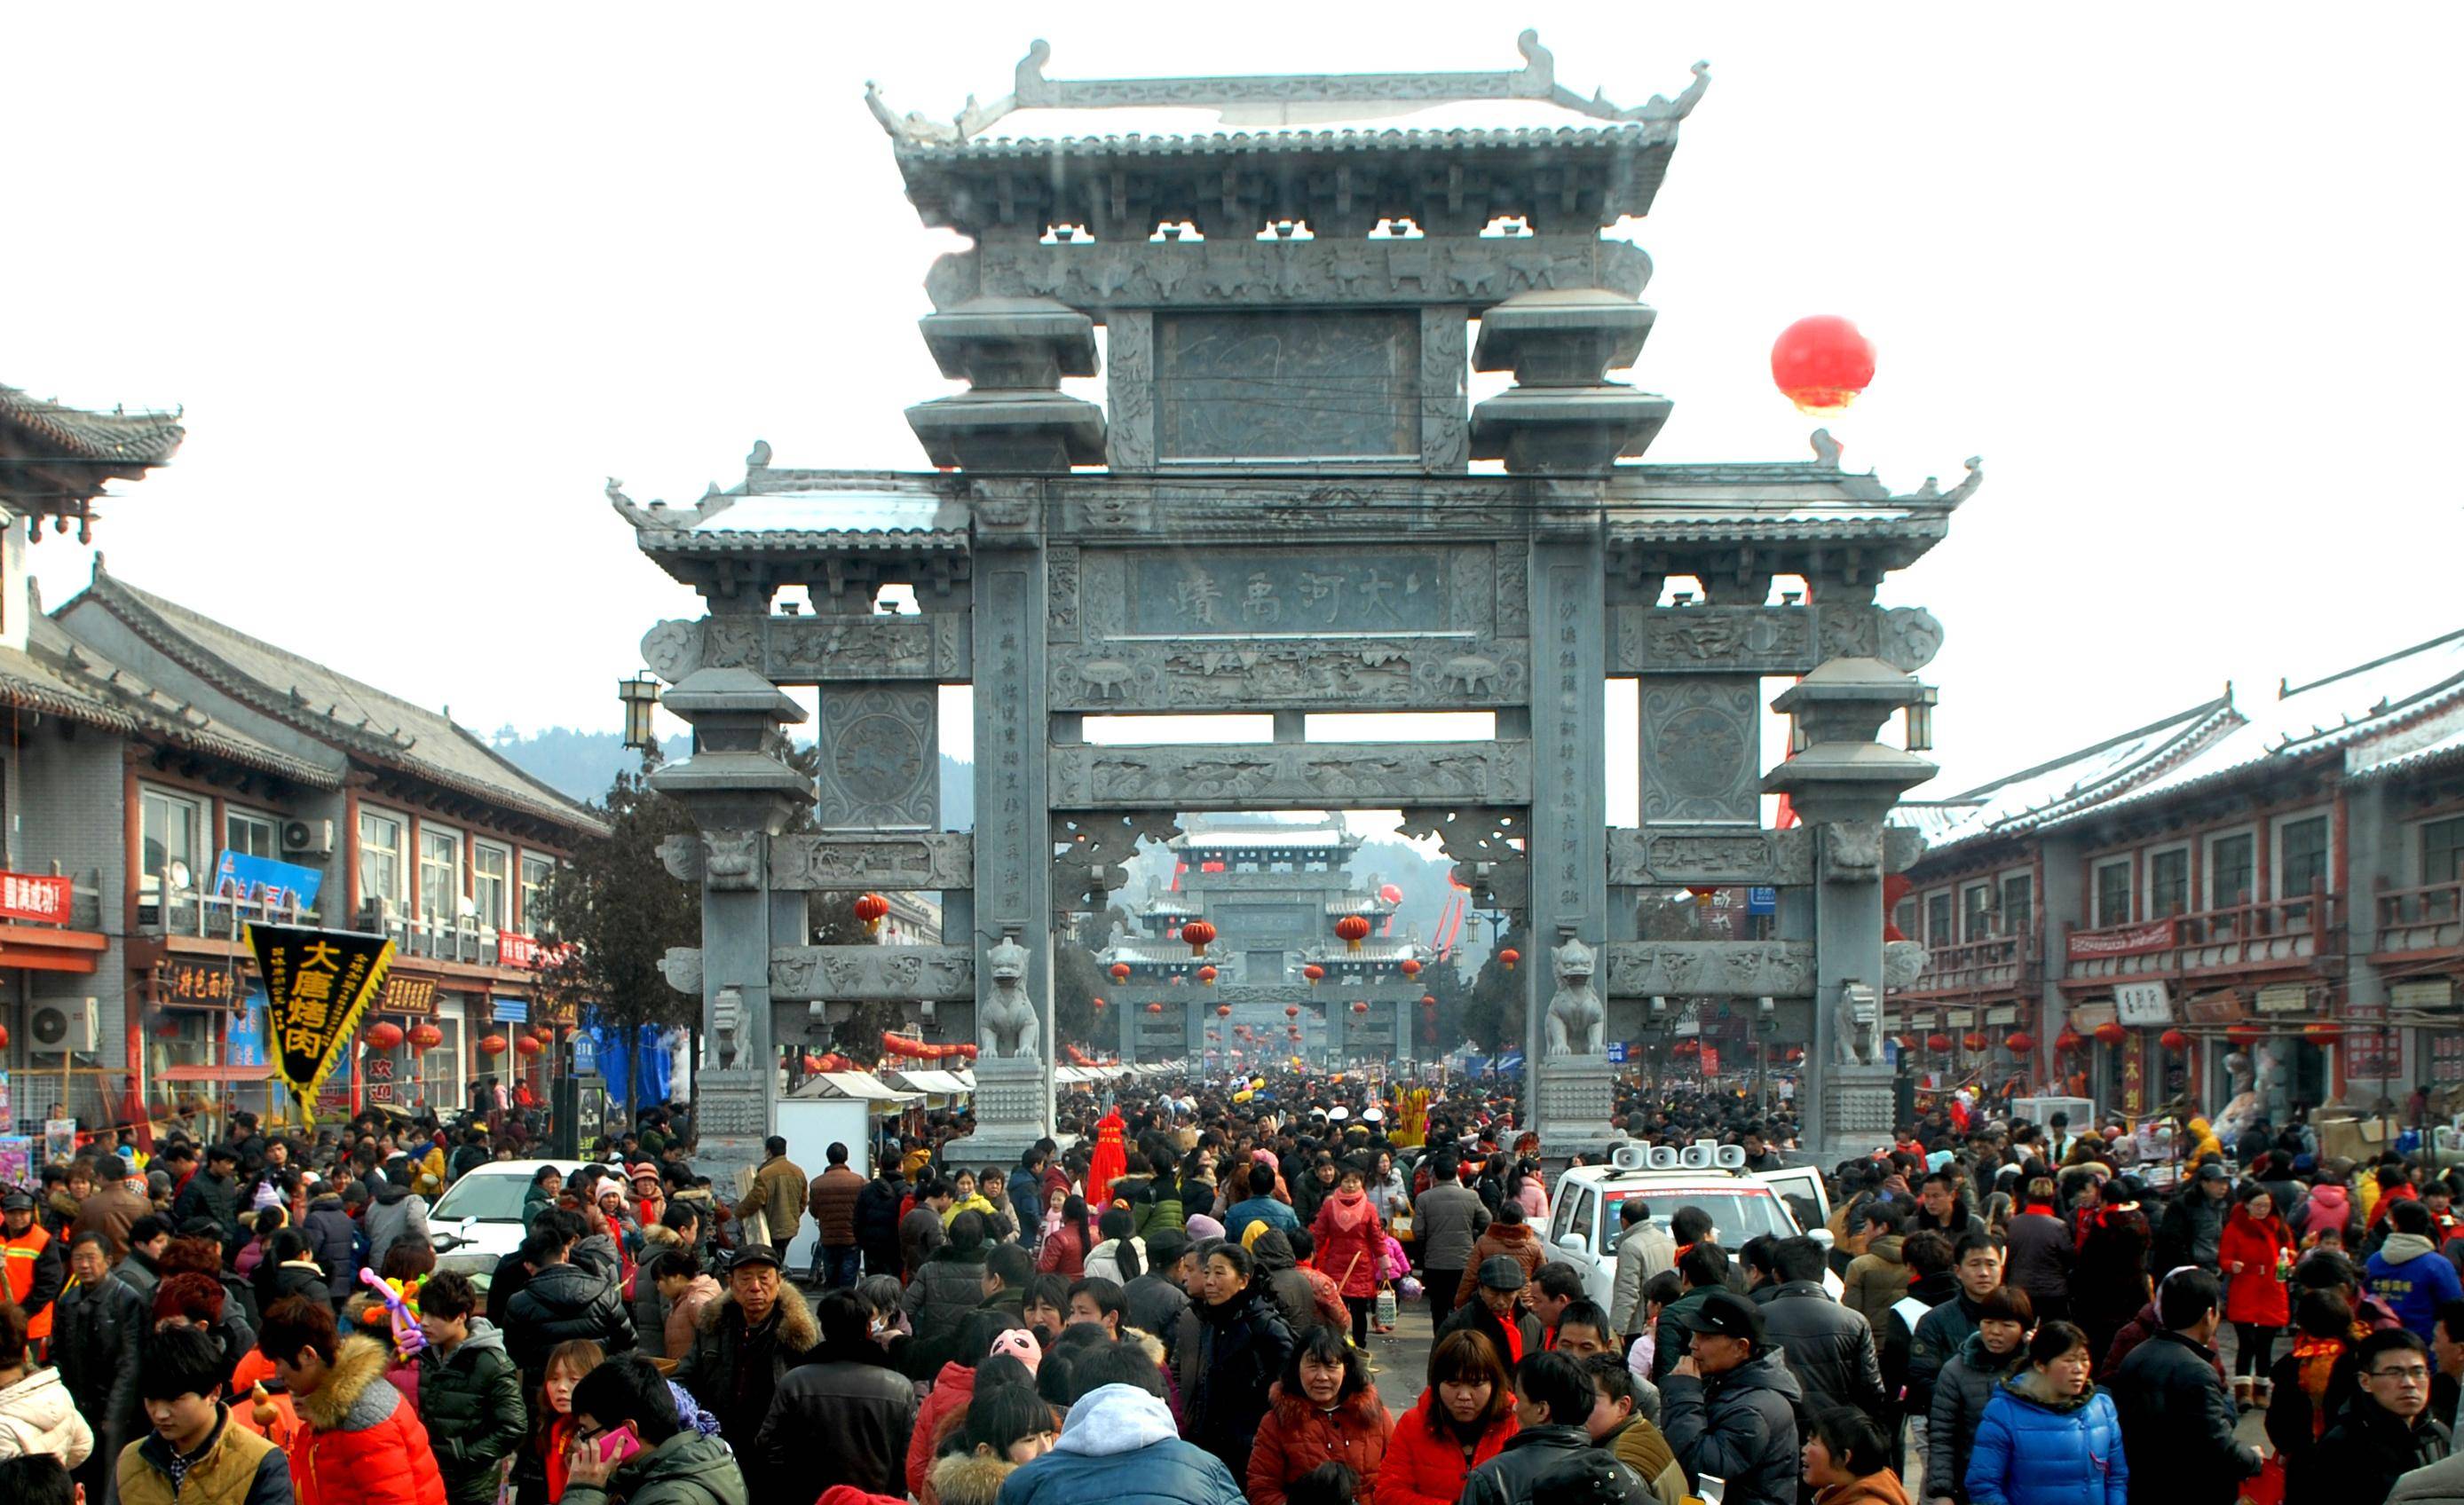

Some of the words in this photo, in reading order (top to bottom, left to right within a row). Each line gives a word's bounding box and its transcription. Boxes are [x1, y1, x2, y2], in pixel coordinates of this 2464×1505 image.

[285, 941, 341, 1059] 大唐烤肉
[369, 1059, 393, 1102] 欢迎
